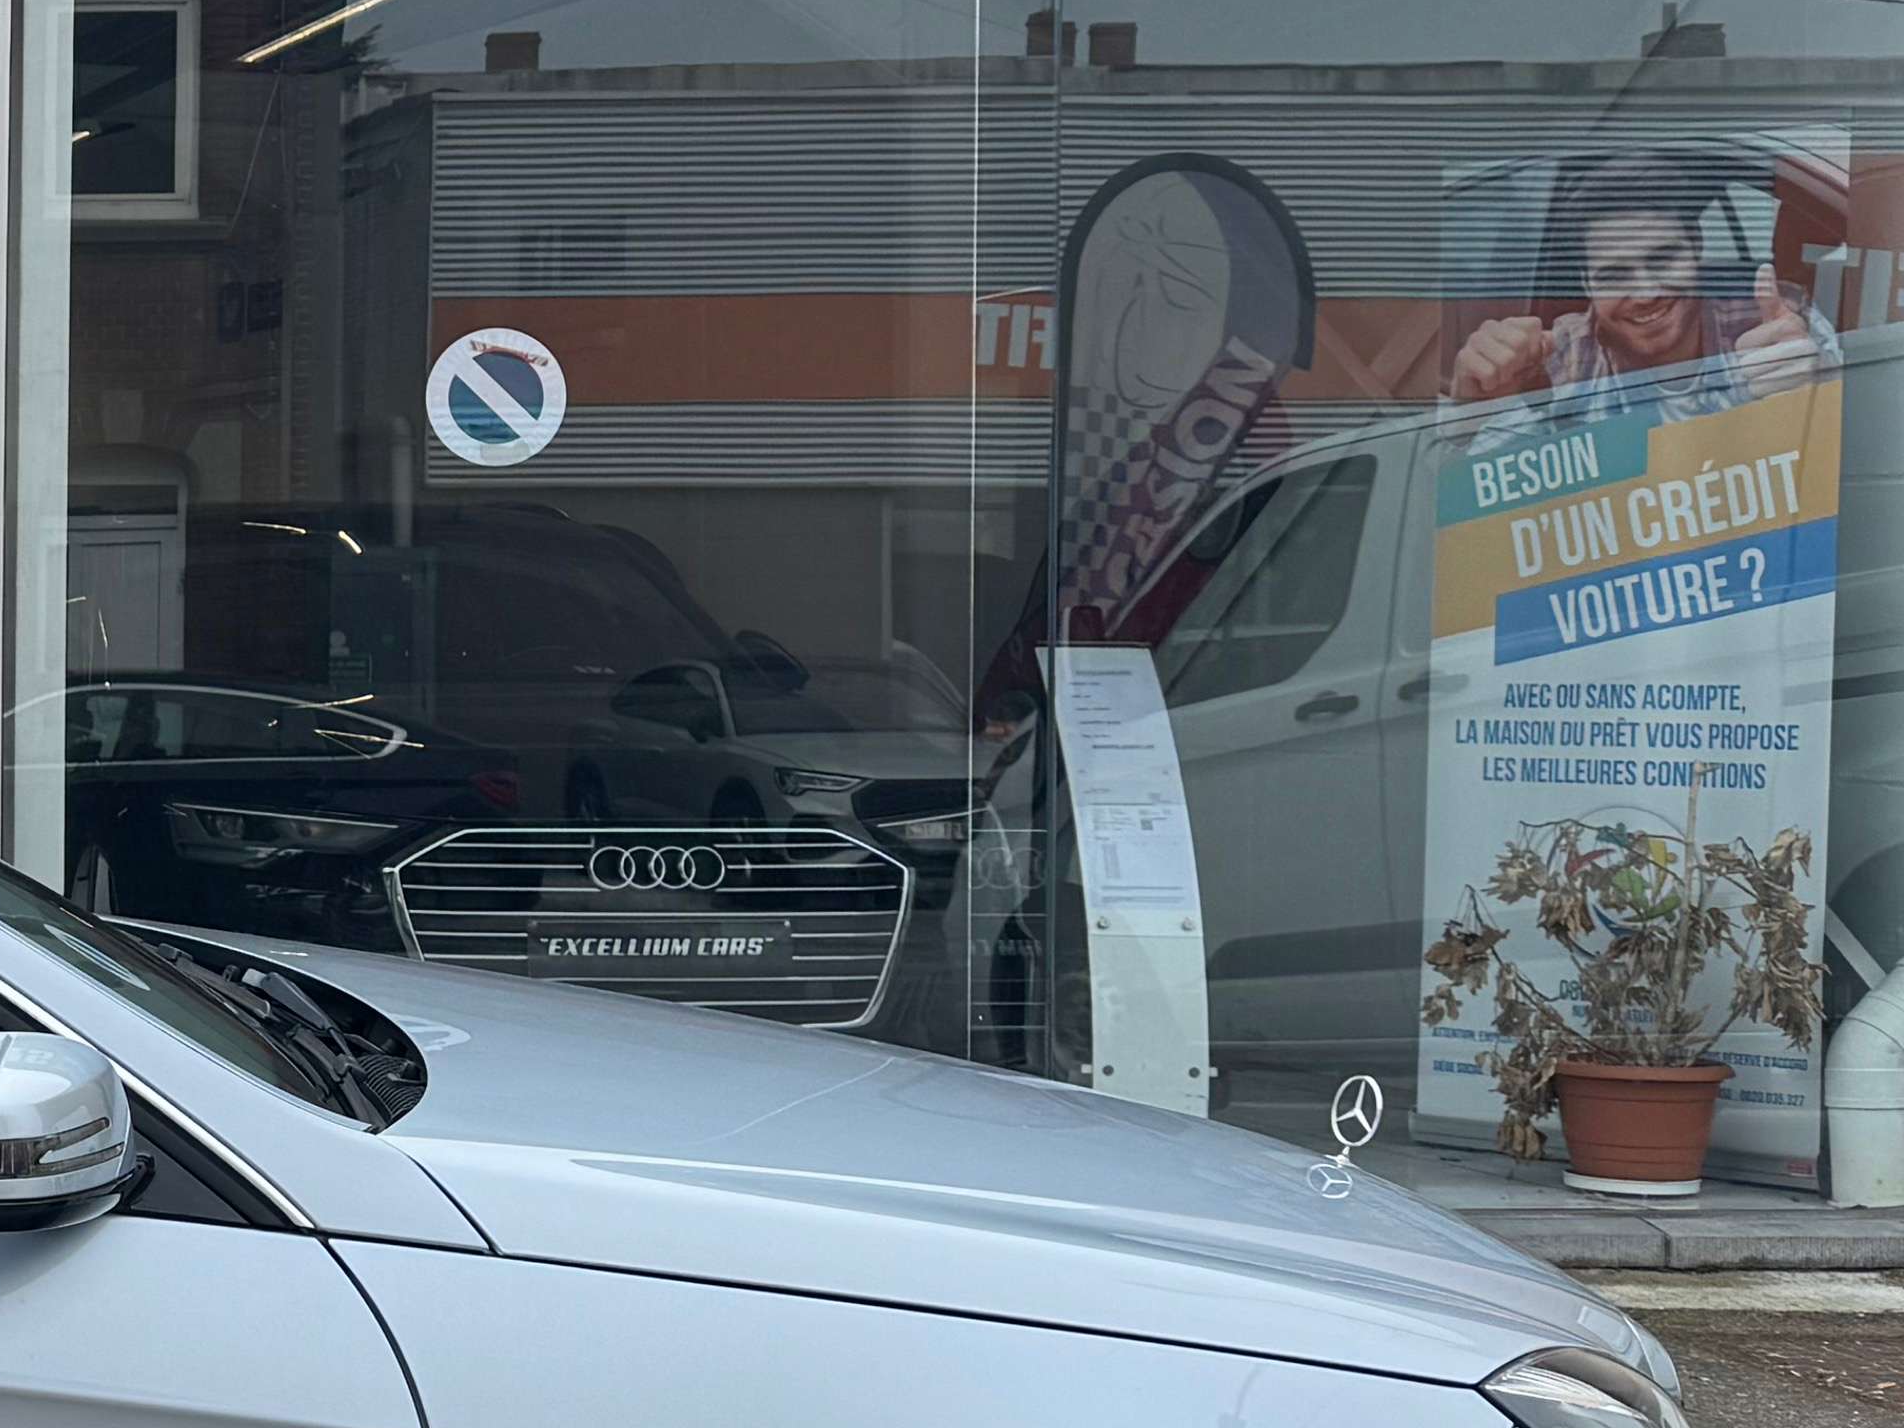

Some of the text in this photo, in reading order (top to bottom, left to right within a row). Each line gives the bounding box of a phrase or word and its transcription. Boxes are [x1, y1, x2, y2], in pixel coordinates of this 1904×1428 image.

[1471, 432, 1600, 509] BESOIN
[1510, 450, 1801, 579] D'UN CRÉDIT
[1548, 547, 1767, 645] VOITURE ?
[1503, 683, 1747, 714] AVEC OU SANS ACOMPTE,
[1455, 717, 1800, 752] LA MAISON DU PRÊT VOUS PROPOSE
[1482, 756, 1516, 782] LES
[1520, 757, 1637, 787] MEILLEURES
[547, 936, 765, 957] EXCELLIUM CARS
